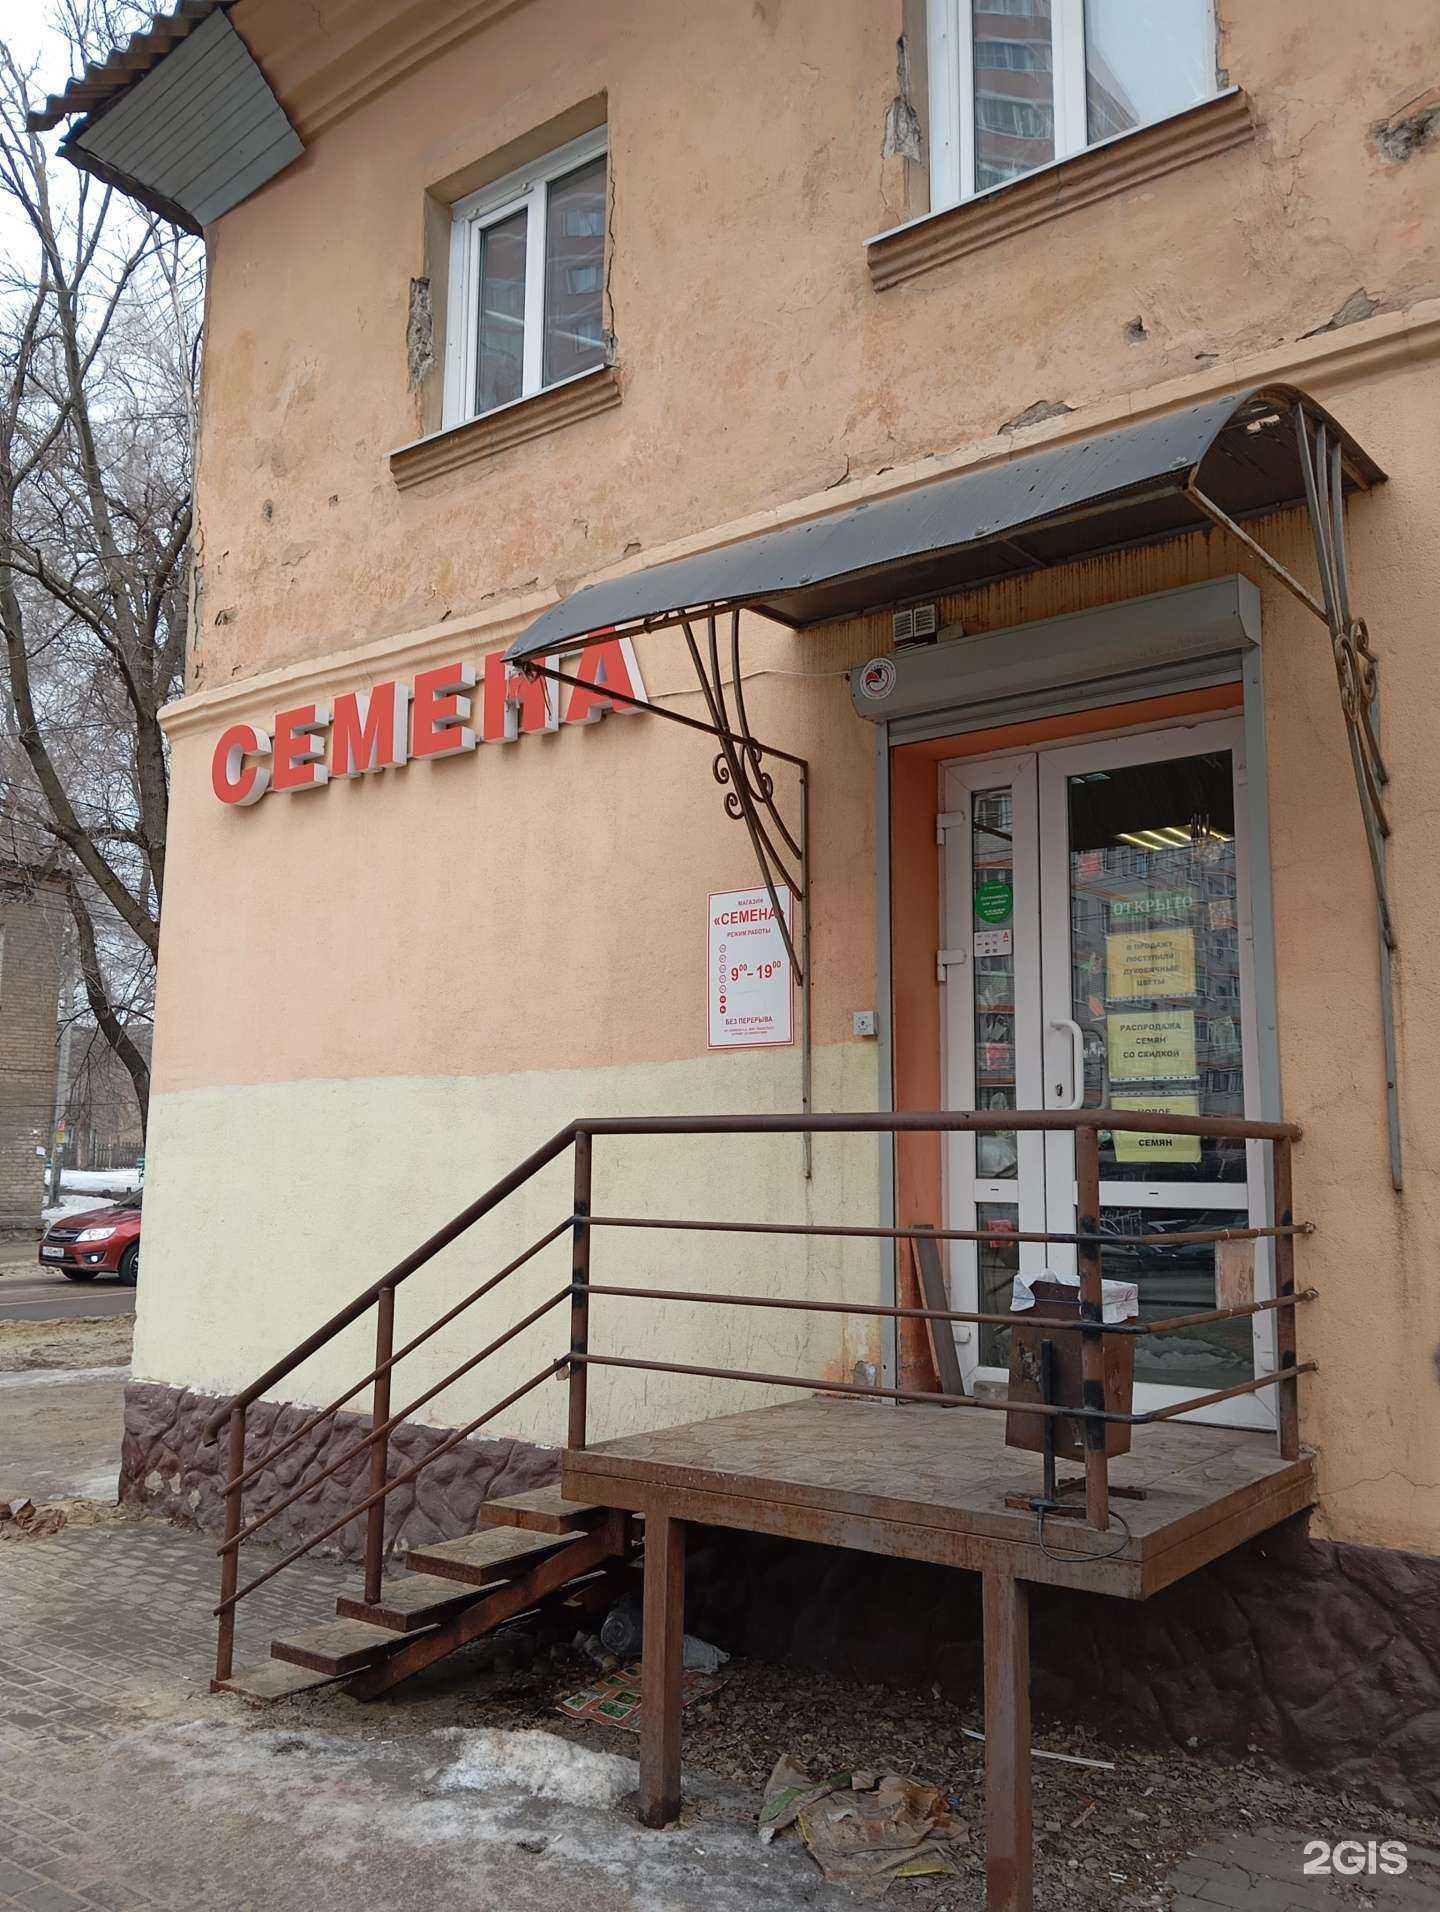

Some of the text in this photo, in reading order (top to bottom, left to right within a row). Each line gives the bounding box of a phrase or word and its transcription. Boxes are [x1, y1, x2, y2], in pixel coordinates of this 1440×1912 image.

[212, 624, 649, 806] СЕМЕНА
[738, 898, 763, 906] МАГАЗИН
[728, 928, 771, 938] РЕЖИМ РАБОТЫ
[739, 1016, 773, 1024] ПЕРЕРЫВА
[1120, 1022, 1181, 1032] РАСПРОДАЖА
[1135, 1037, 1167, 1045] СЕМЯН
[1123, 1051, 1135, 1059] СО
[1138, 1139, 1173, 1147] СЕМЯН
